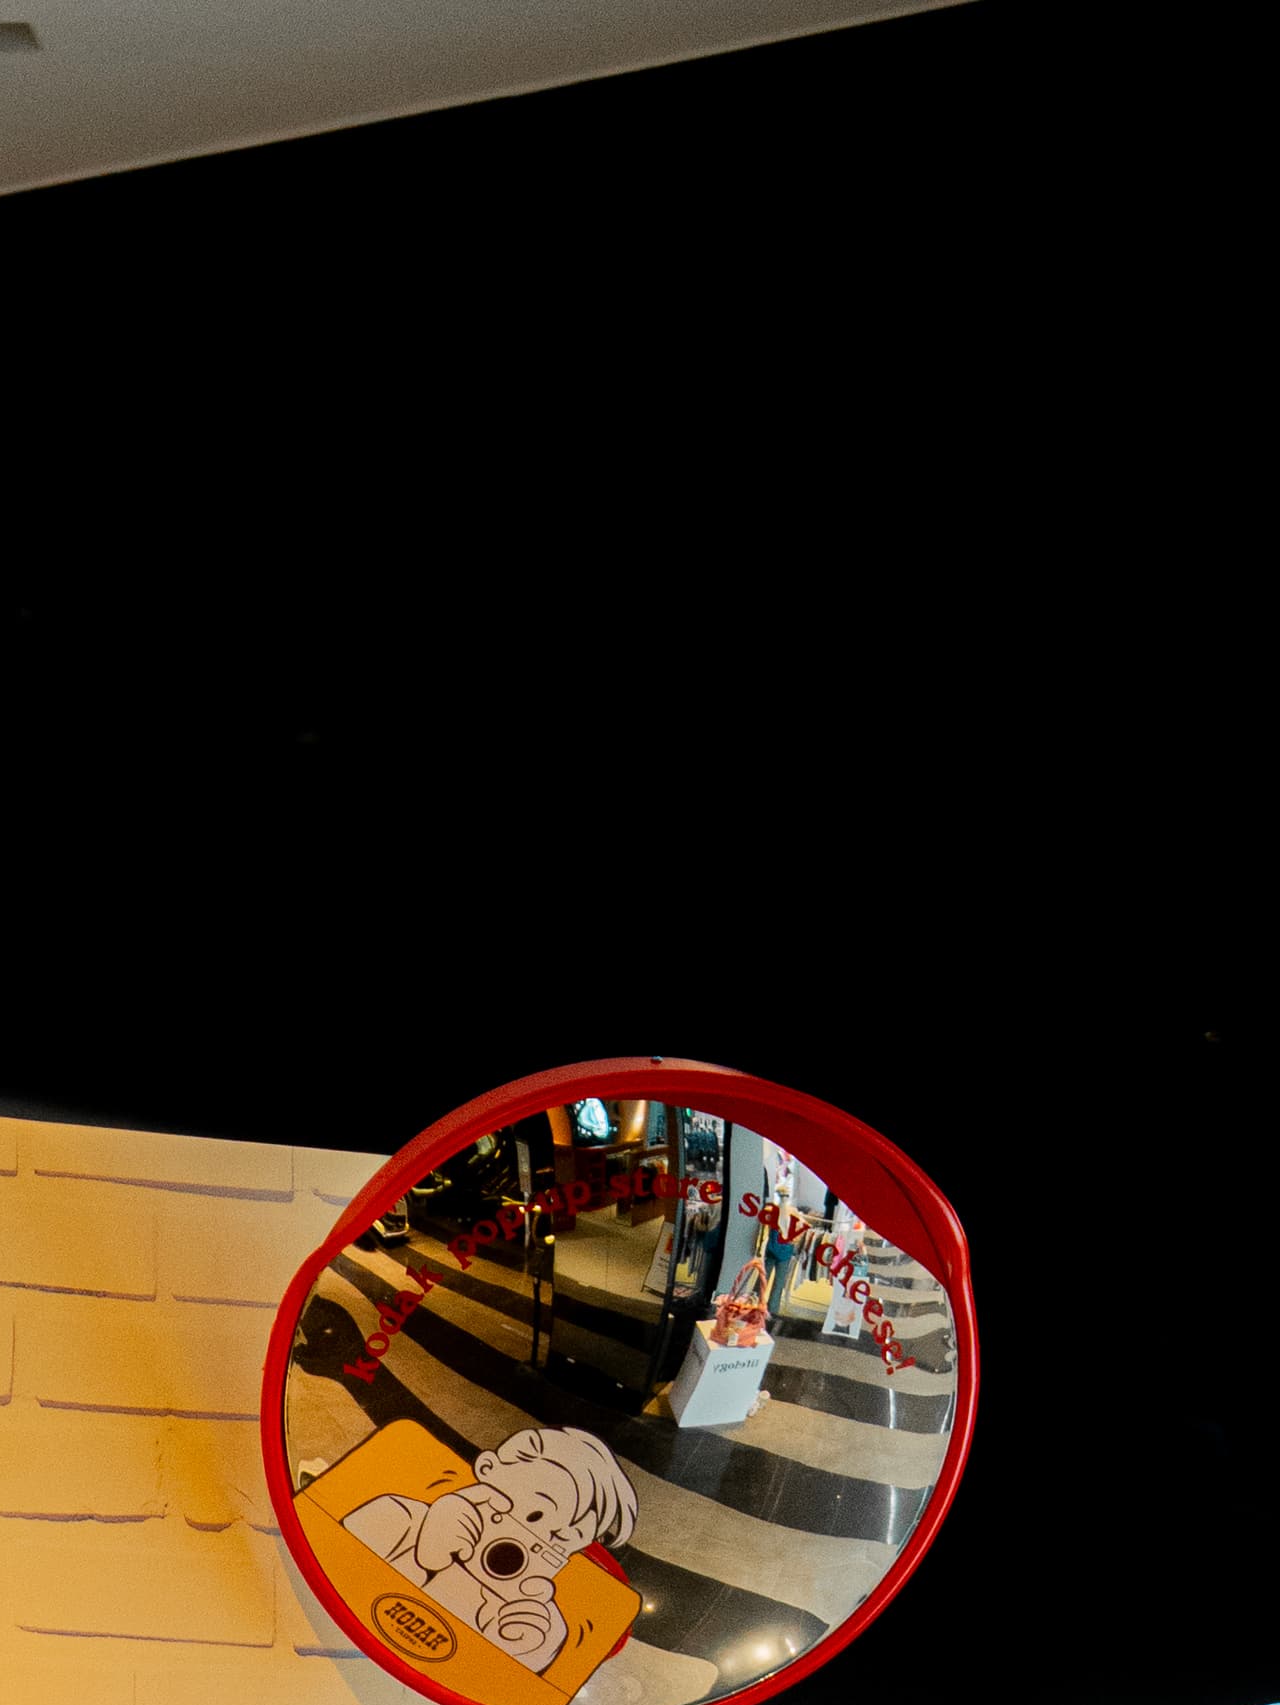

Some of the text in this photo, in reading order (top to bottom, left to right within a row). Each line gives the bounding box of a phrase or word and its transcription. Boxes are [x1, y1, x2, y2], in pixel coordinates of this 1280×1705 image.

[343, 1264, 444, 1384] kodak
[609, 1167, 723, 1204] store
[738, 1192, 811, 1244] say
[816, 1243, 916, 1376] cheese!
[384, 1602, 449, 1651] KODAK
